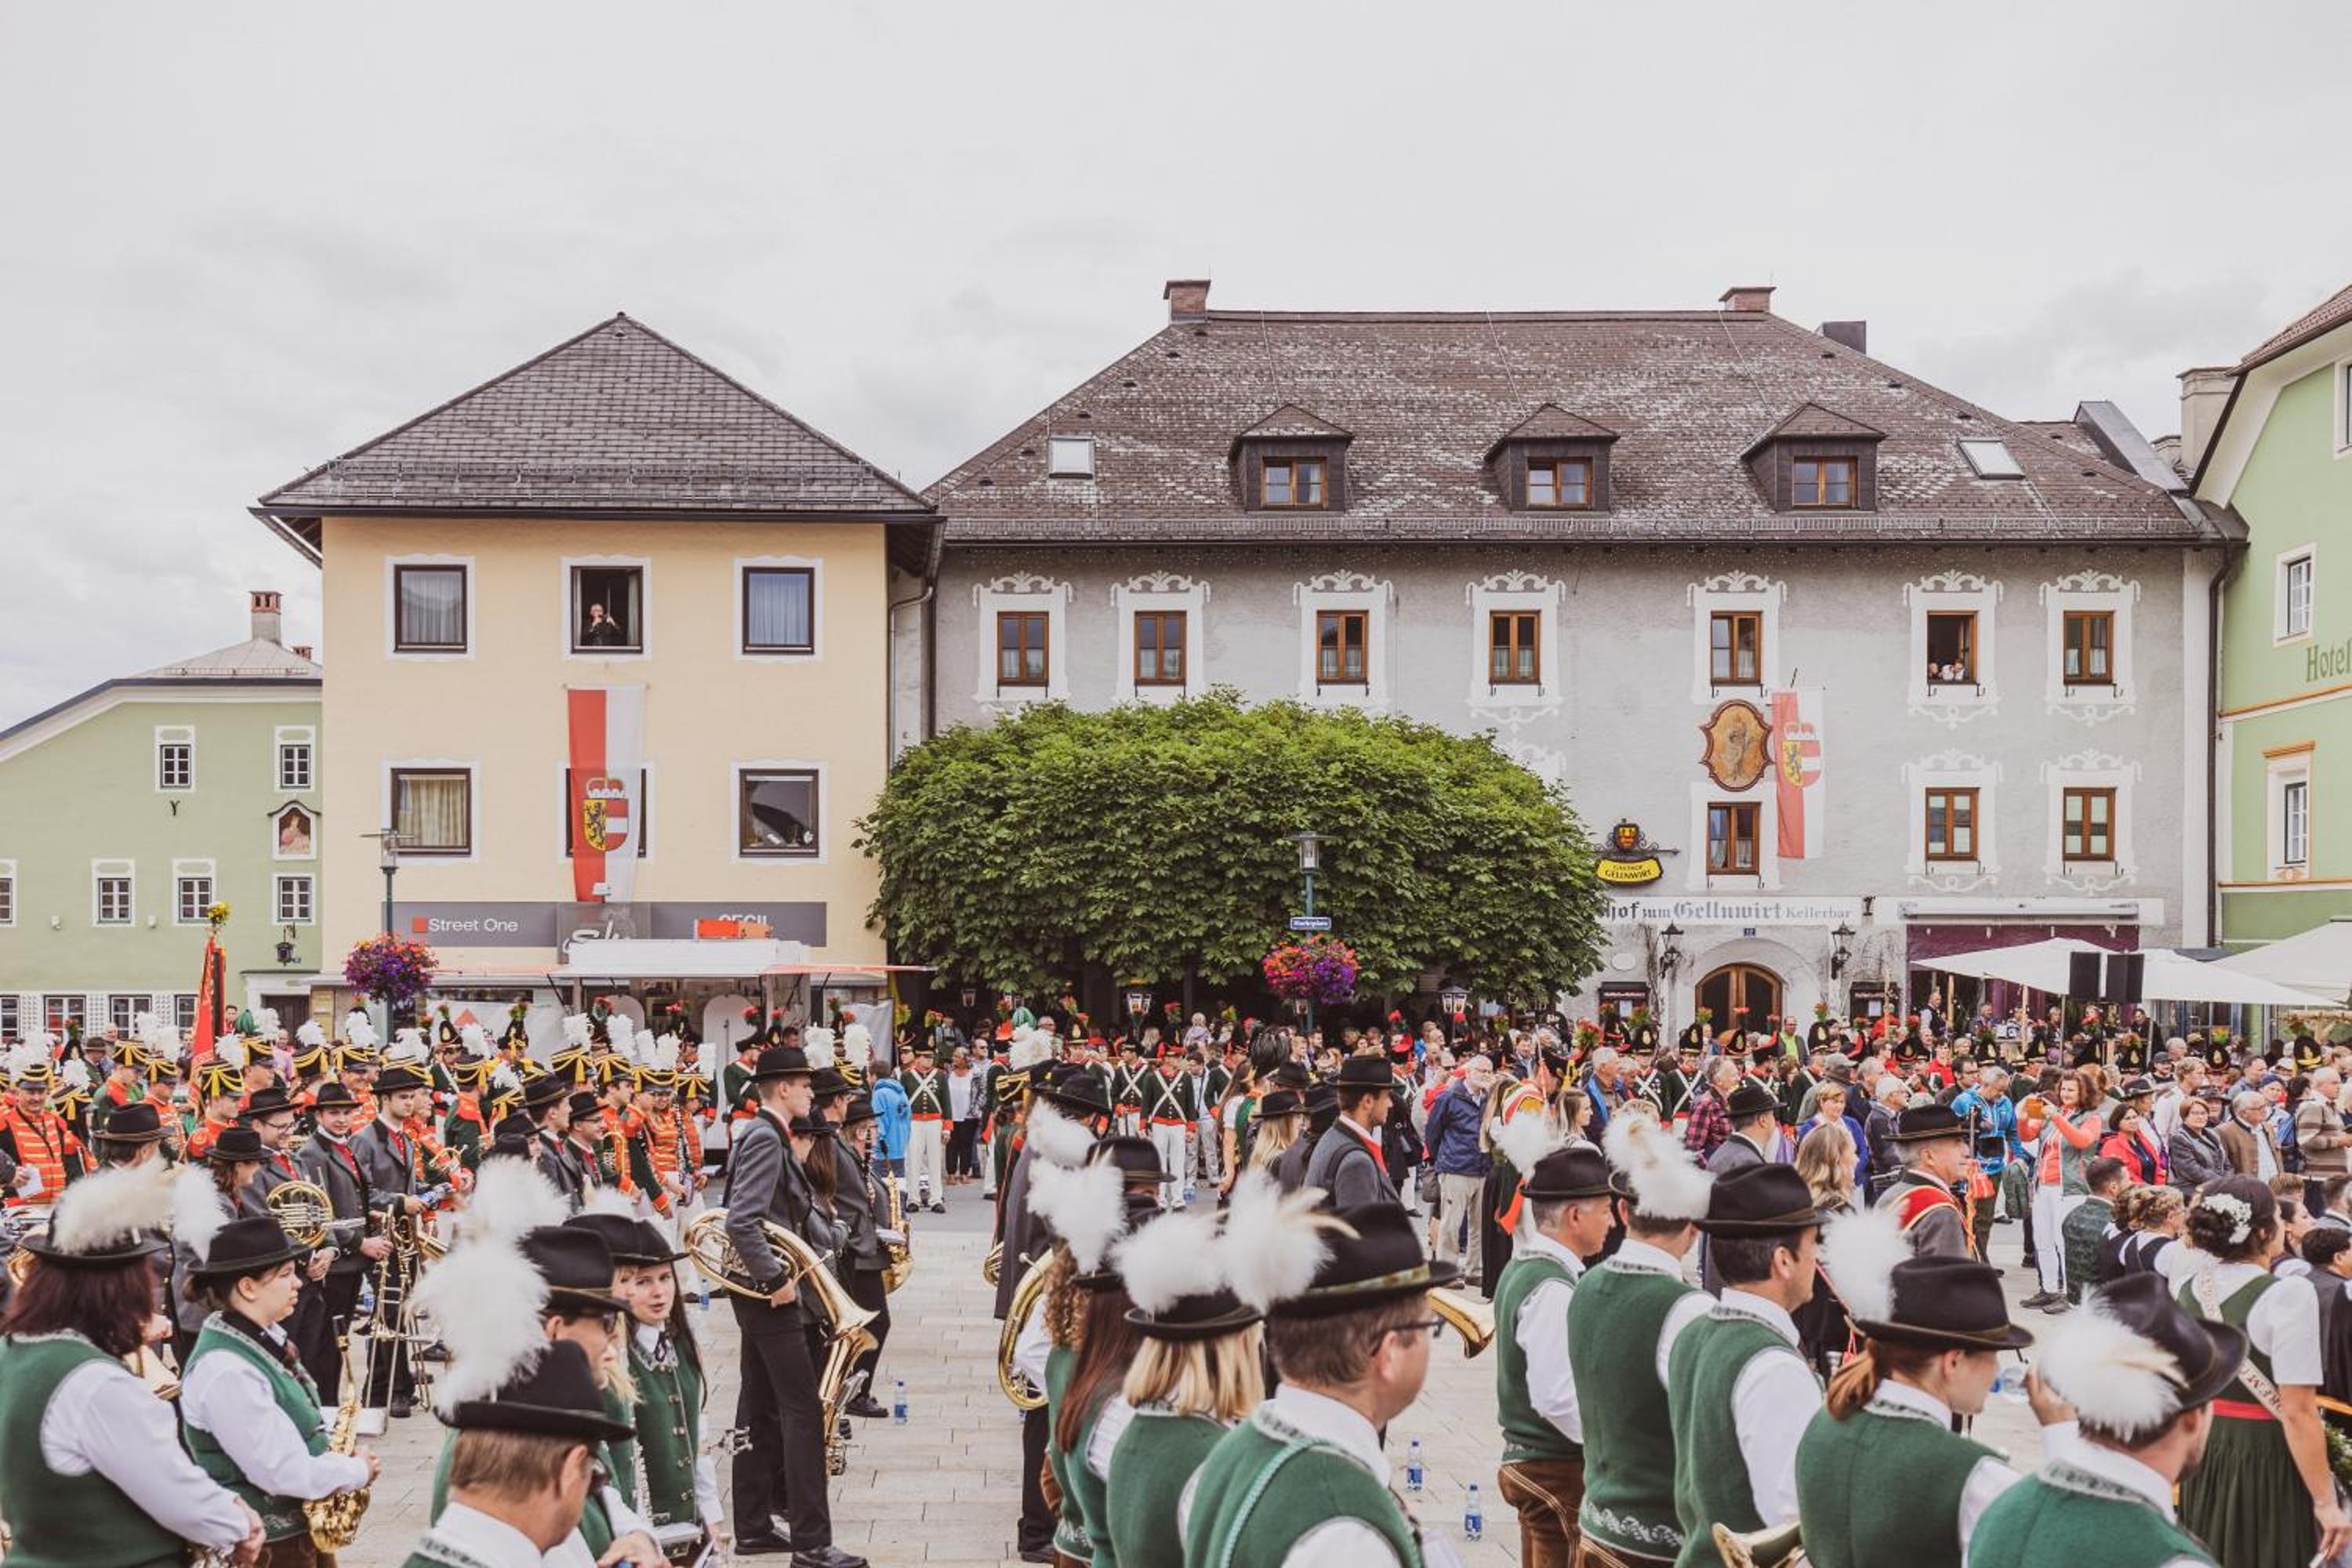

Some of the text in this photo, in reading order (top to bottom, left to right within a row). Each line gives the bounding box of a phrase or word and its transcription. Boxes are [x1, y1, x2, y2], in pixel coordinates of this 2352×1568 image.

[2307, 638, 2350, 681] Hotel
[1642, 906, 1671, 919] zum
[1673, 901, 1782, 920] Gellnwirt
[1785, 906, 1851, 919] Kellerbar
[428, 918, 518, 932] Street One
